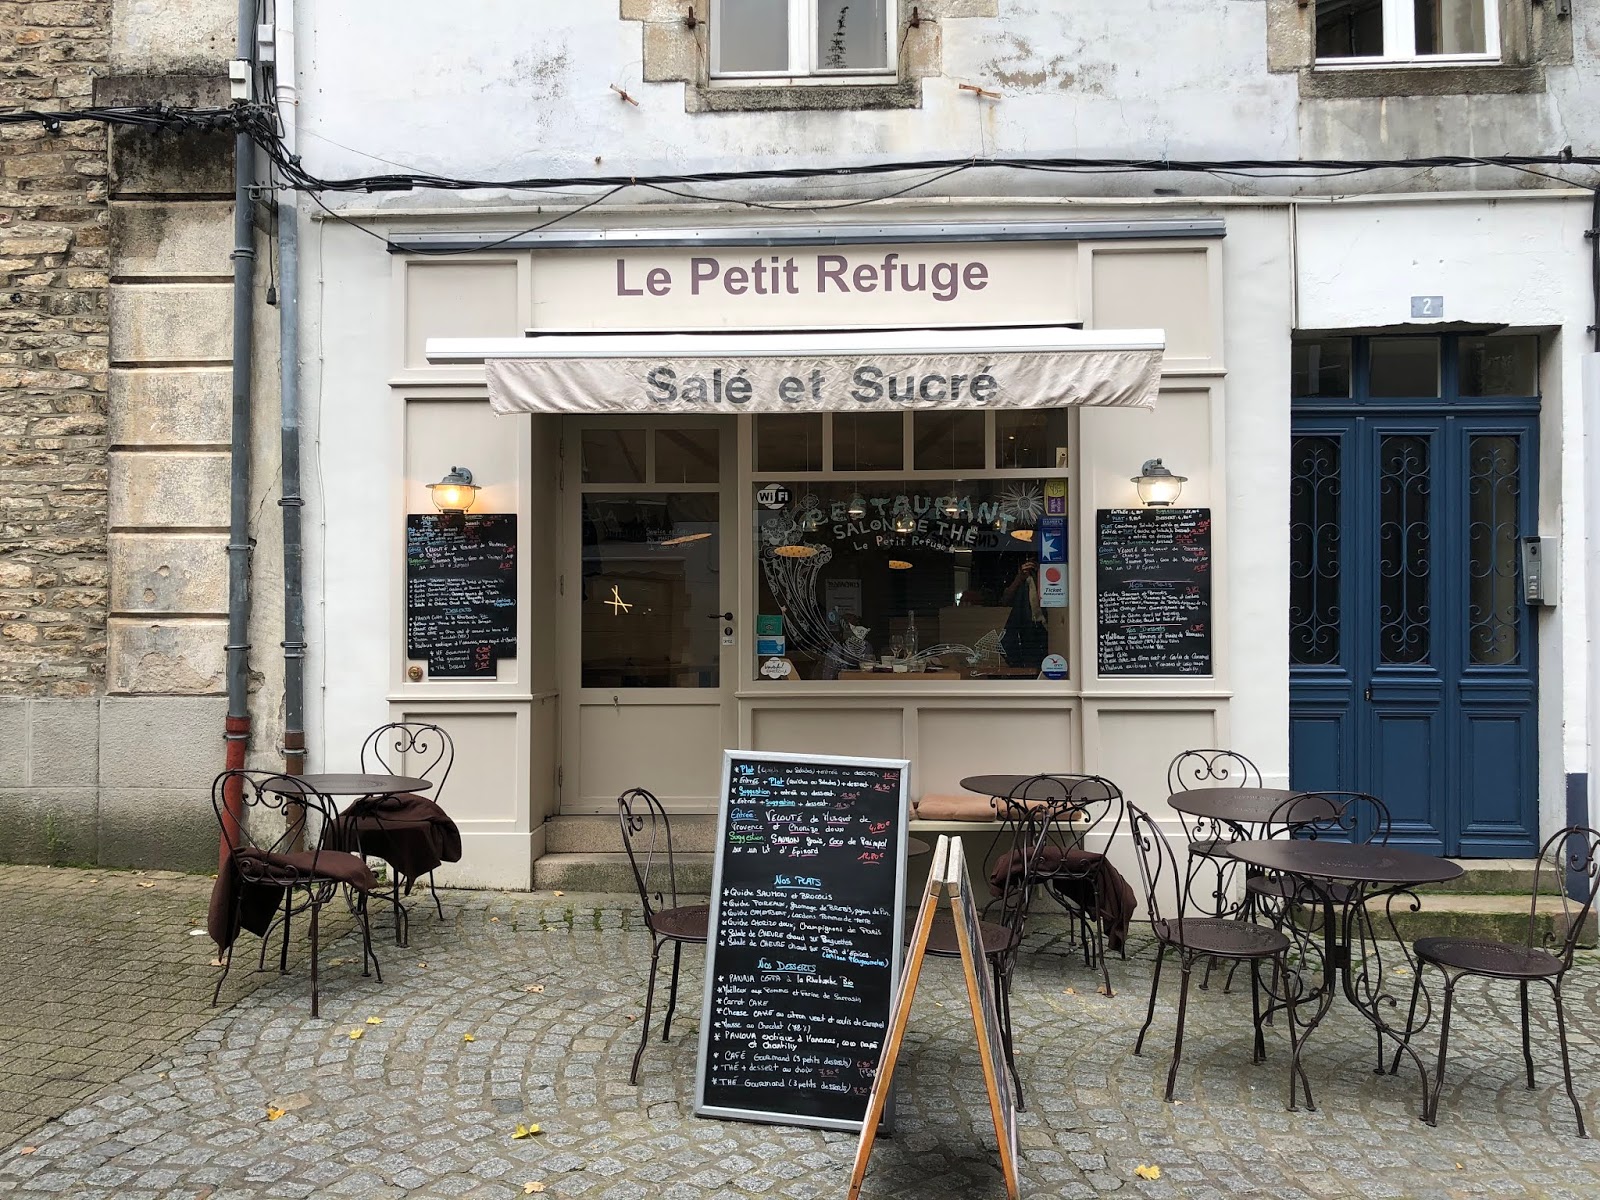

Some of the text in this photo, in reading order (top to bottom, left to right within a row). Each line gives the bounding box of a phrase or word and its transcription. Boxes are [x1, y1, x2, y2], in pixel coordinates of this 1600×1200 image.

[617, 253, 989, 301] Le Petit Refuge
[1423, 298, 1431, 314] 2
[646, 364, 998, 404] Salé et Sucré
[833, 517, 896, 540] SALON
[853, 541, 868, 551] Le
[876, 535, 906, 547] Petit
[911, 536, 947, 552] Refuge
[768, 776, 785, 785] Plat
[810, 815, 819, 823] de
[859, 815, 871, 823] de
[731, 821, 764, 832] Provence
[773, 822, 780, 830] et
[847, 837, 857, 845] de
[773, 874, 791, 885] Nos
[730, 887, 754, 897] Quiche
[729, 899, 750, 907] Quiche
[727, 908, 748, 917] Quiche
[727, 917, 749, 926] Quiche
[847, 925, 856, 933] de
[749, 928, 756, 938] de
[749, 938, 757, 947] de
[729, 973, 755, 983] PANNA
[822, 991, 831, 1000] de
